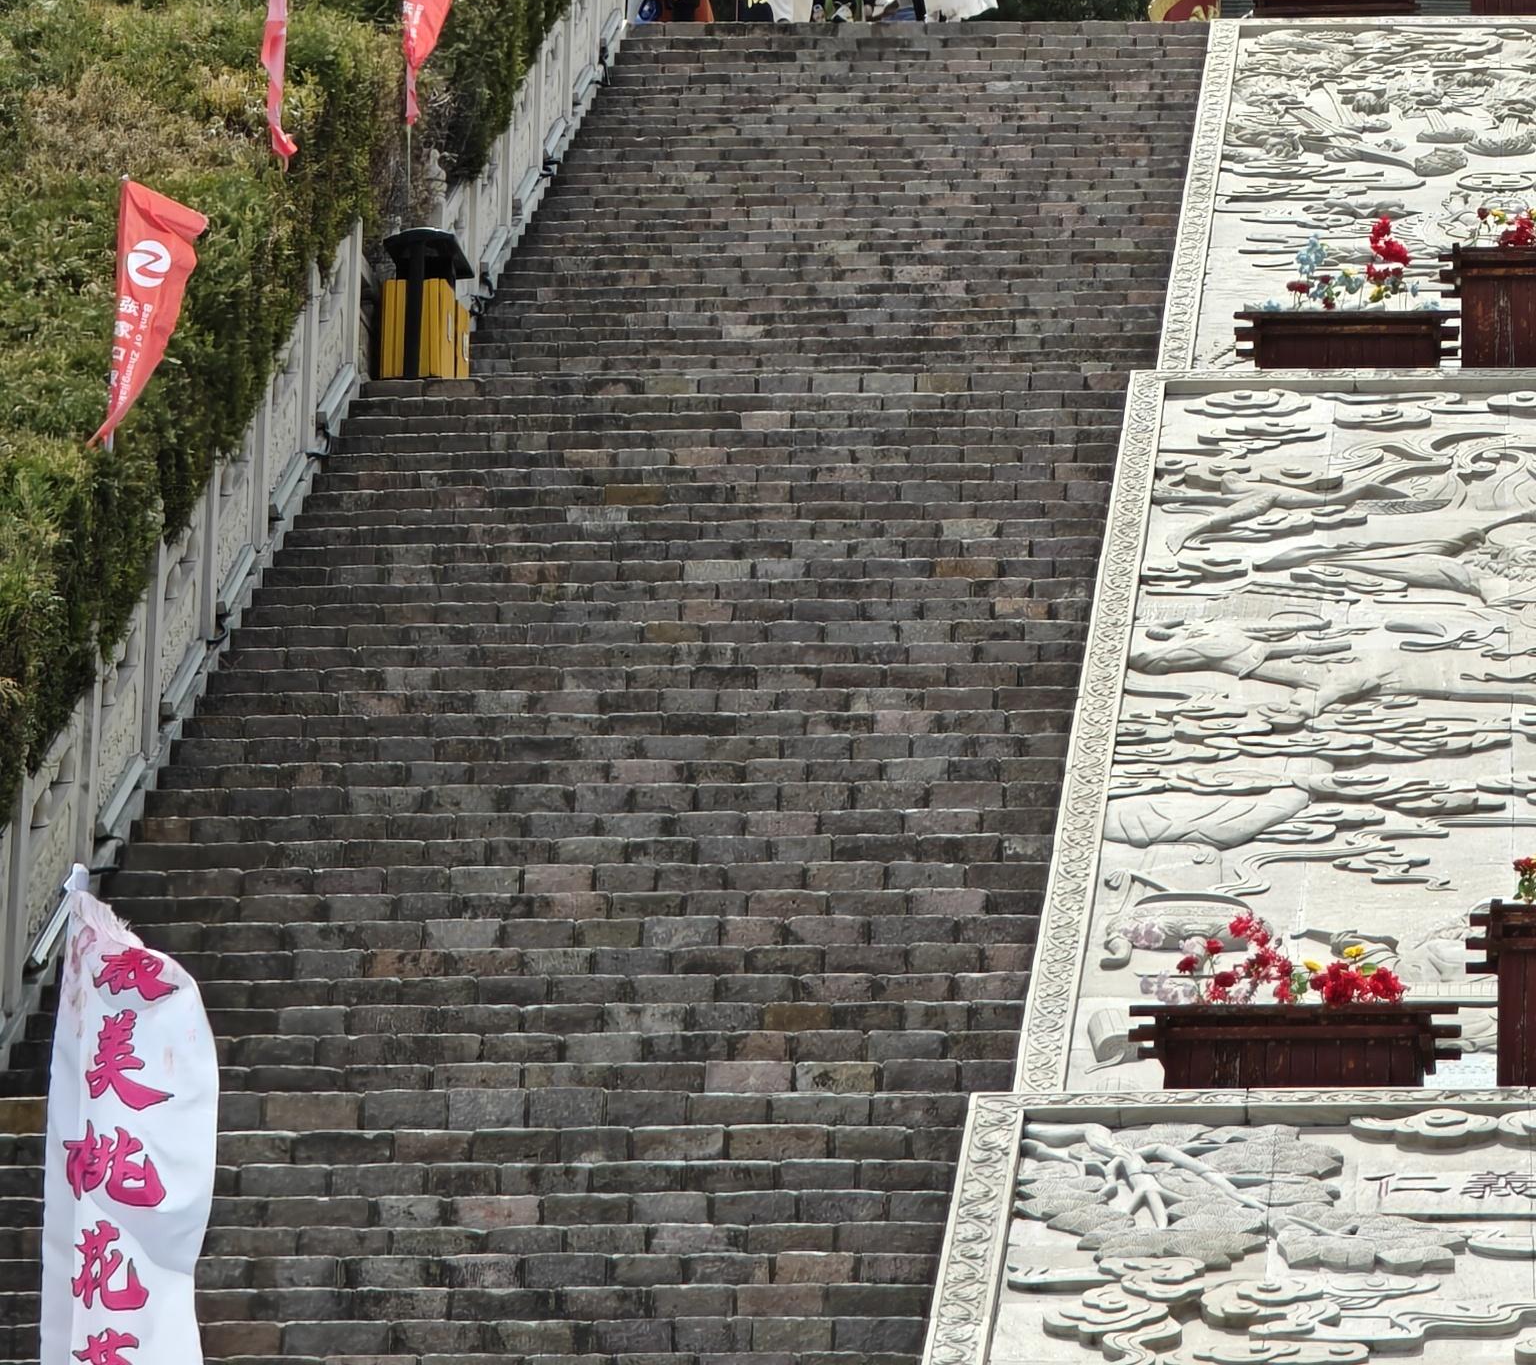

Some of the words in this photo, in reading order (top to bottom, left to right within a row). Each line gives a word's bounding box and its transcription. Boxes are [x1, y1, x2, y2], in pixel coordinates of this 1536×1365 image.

[139, 303, 153, 330] Bank
[133, 333, 143, 347] of
[117, 350, 140, 407] Zhangjiak
